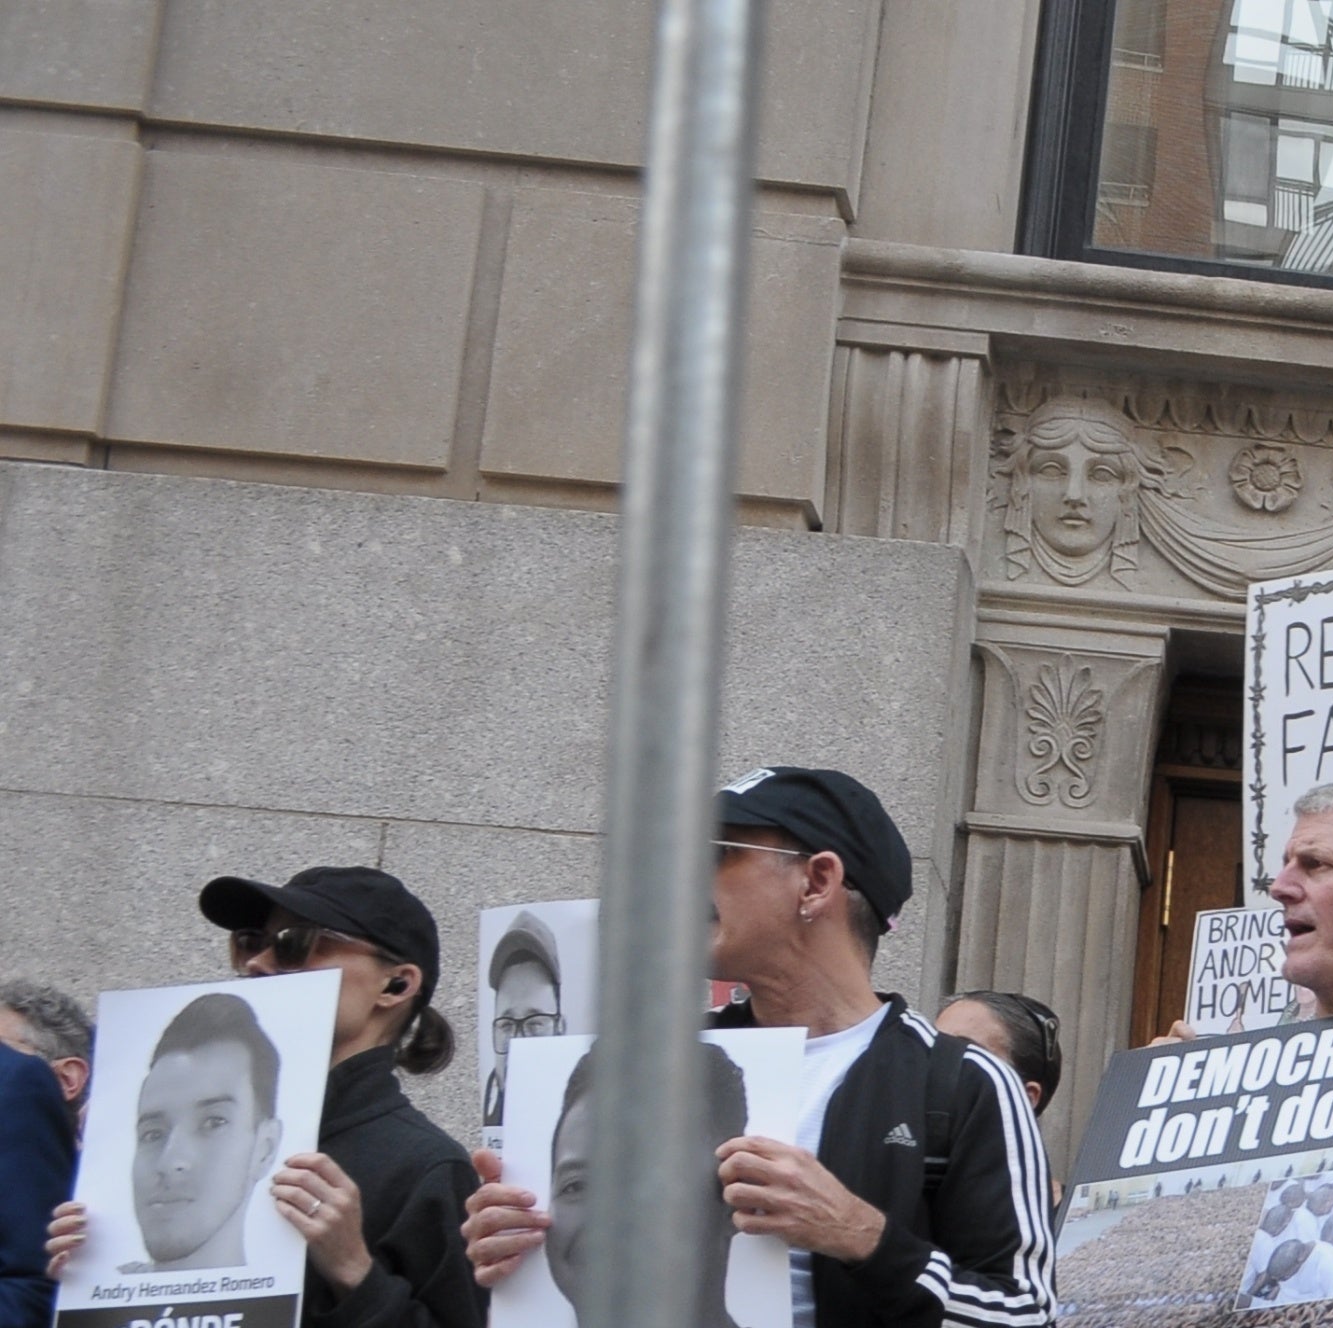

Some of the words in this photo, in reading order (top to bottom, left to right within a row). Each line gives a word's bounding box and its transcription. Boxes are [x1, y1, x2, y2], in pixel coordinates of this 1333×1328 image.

[1208, 909, 1286, 944] BRING
[1119, 1094, 1270, 1169] don't
[90, 1284, 134, 1302] Andry
[139, 1278, 217, 1297] Hernandez
[221, 1275, 275, 1292] Romero
